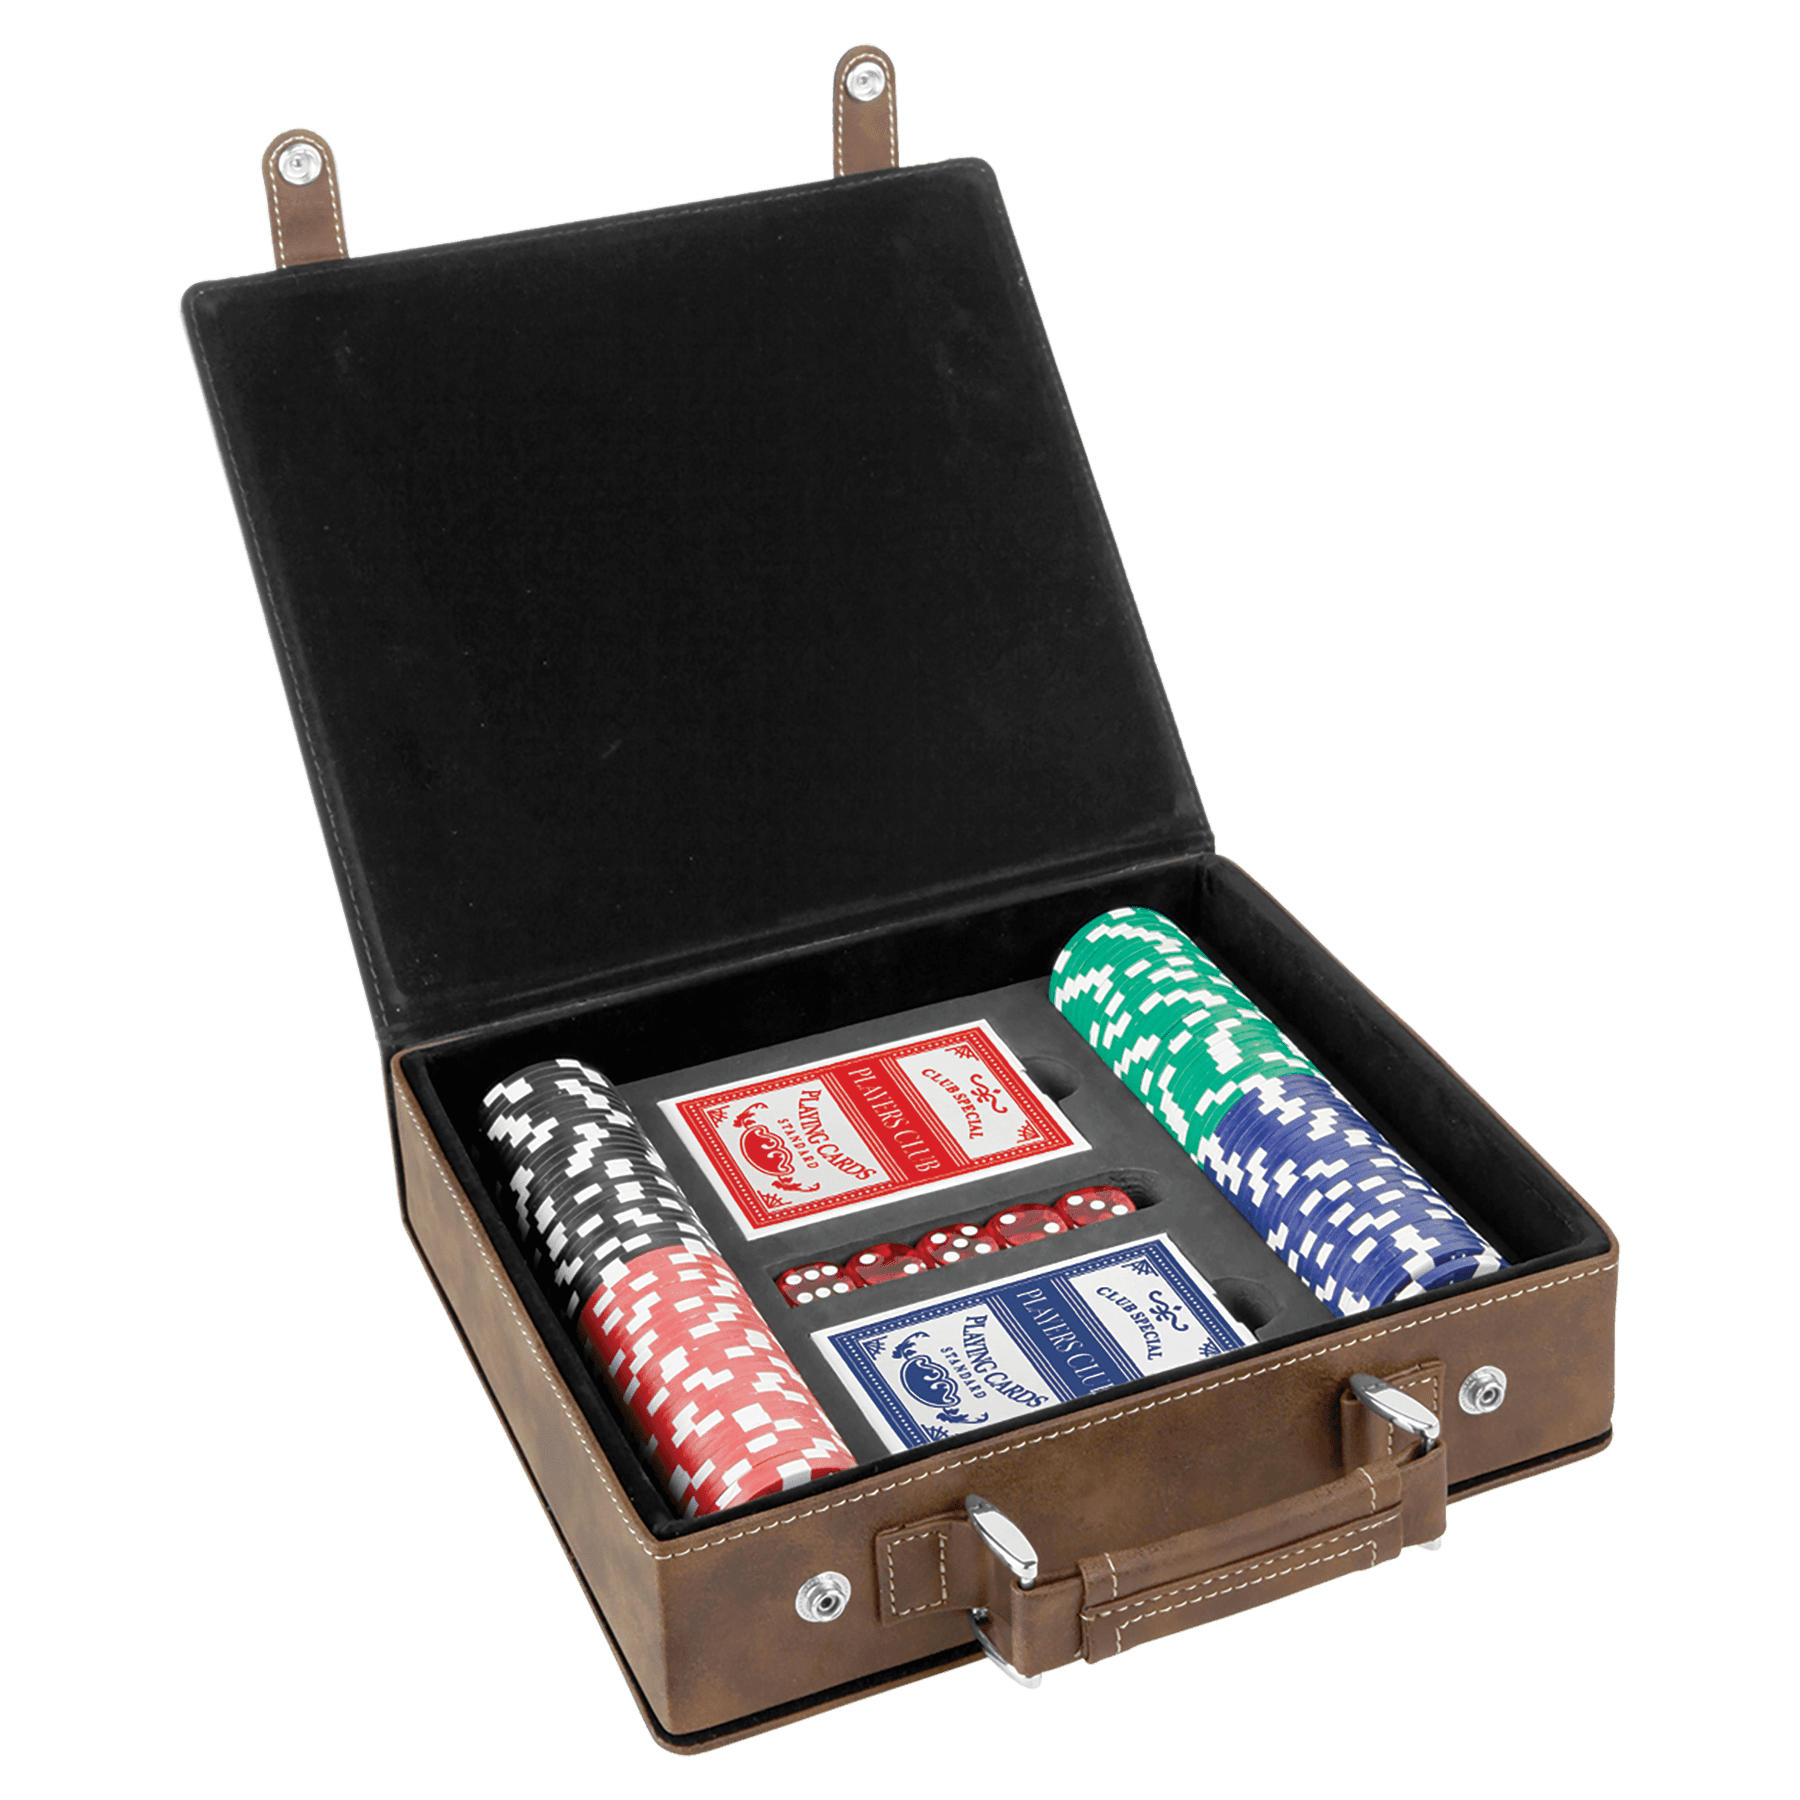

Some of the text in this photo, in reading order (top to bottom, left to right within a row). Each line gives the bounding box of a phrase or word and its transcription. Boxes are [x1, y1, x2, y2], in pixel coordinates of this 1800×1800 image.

[798, 1089, 877, 1180] PLAYING CARDS
[848, 1067, 941, 1172] PLAYERS CLUB
[921, 1068, 984, 1139] CLUB SPECIAL
[777, 1118, 819, 1169] STANDARD
[1016, 1288, 1083, 1352] PLAYERS
[1096, 1286, 1163, 1360] CLUB SPECIAL
[940, 1347, 987, 1399] STANDARD
[962, 1314, 1049, 1408] PLAYING CARDS
